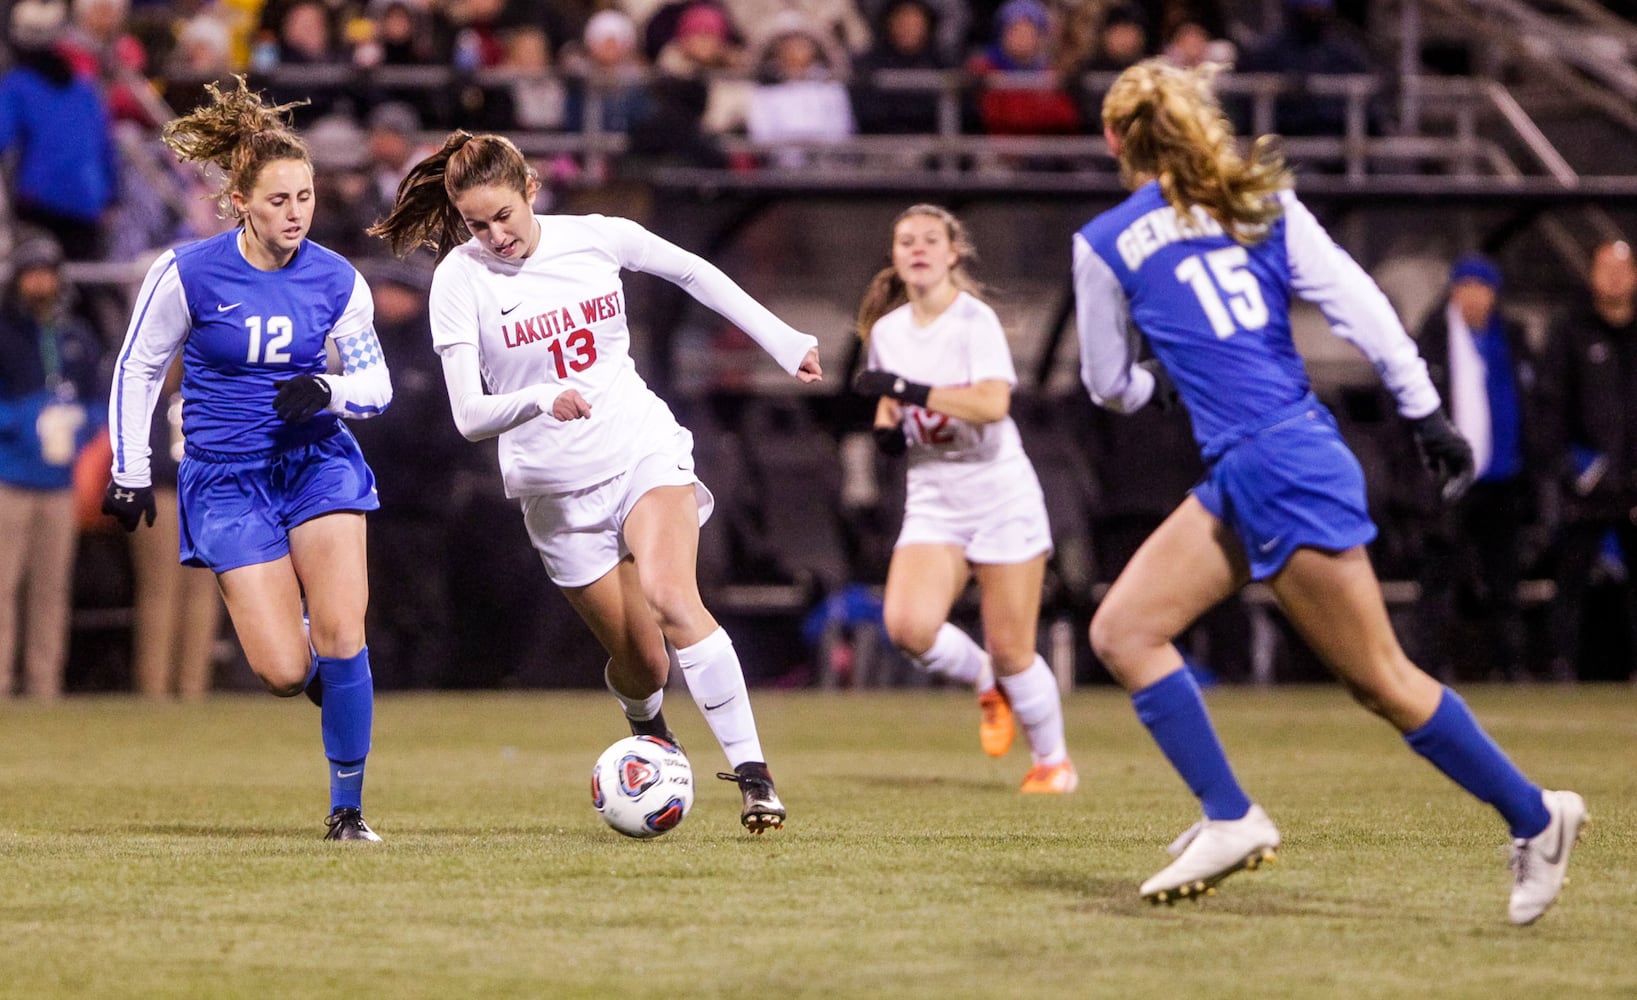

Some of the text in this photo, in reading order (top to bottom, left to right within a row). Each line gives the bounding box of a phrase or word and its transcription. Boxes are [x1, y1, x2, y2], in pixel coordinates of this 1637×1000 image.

[501, 290, 621, 349] LAKOTA WEST
[1174, 245, 1270, 341] 15
[244, 315, 293, 364] 12
[547, 328, 598, 380] 13
